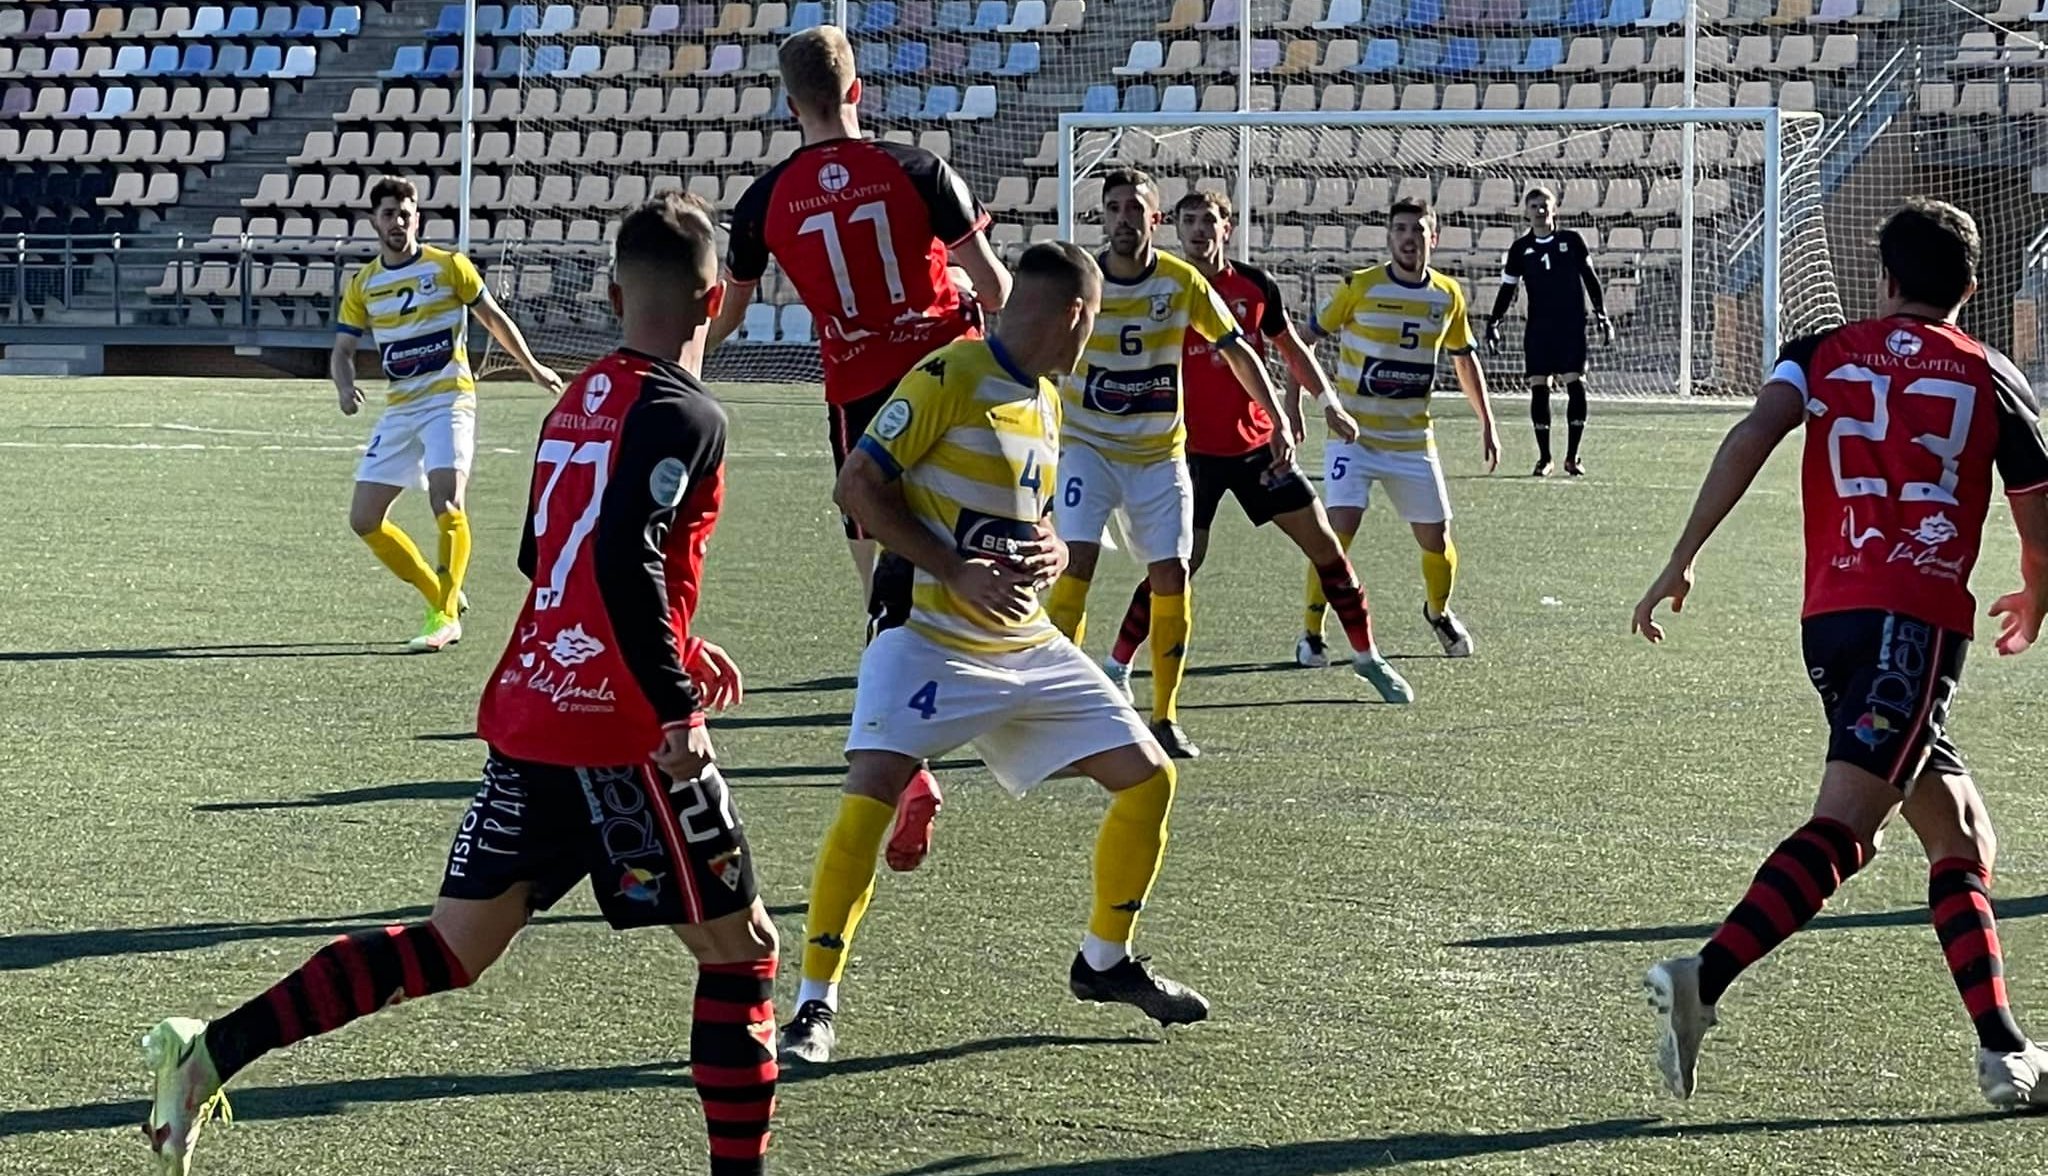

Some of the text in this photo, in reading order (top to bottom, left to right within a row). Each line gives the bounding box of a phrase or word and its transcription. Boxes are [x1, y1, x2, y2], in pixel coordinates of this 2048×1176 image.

[788, 193, 839, 213] HUELVA
[797, 200, 906, 317] 11
[1540, 253, 1552, 270] 1
[397, 286, 418, 316] 2
[1119, 325, 1143, 356] 6
[1400, 321, 1420, 350] 5
[365, 435, 382, 458] 2
[1824, 363, 1977, 506] 23
[1019, 449, 1041, 492] 4
[1331, 456, 1351, 480] 5
[1064, 477, 1083, 508] 6
[908, 680, 938, 720] 4
